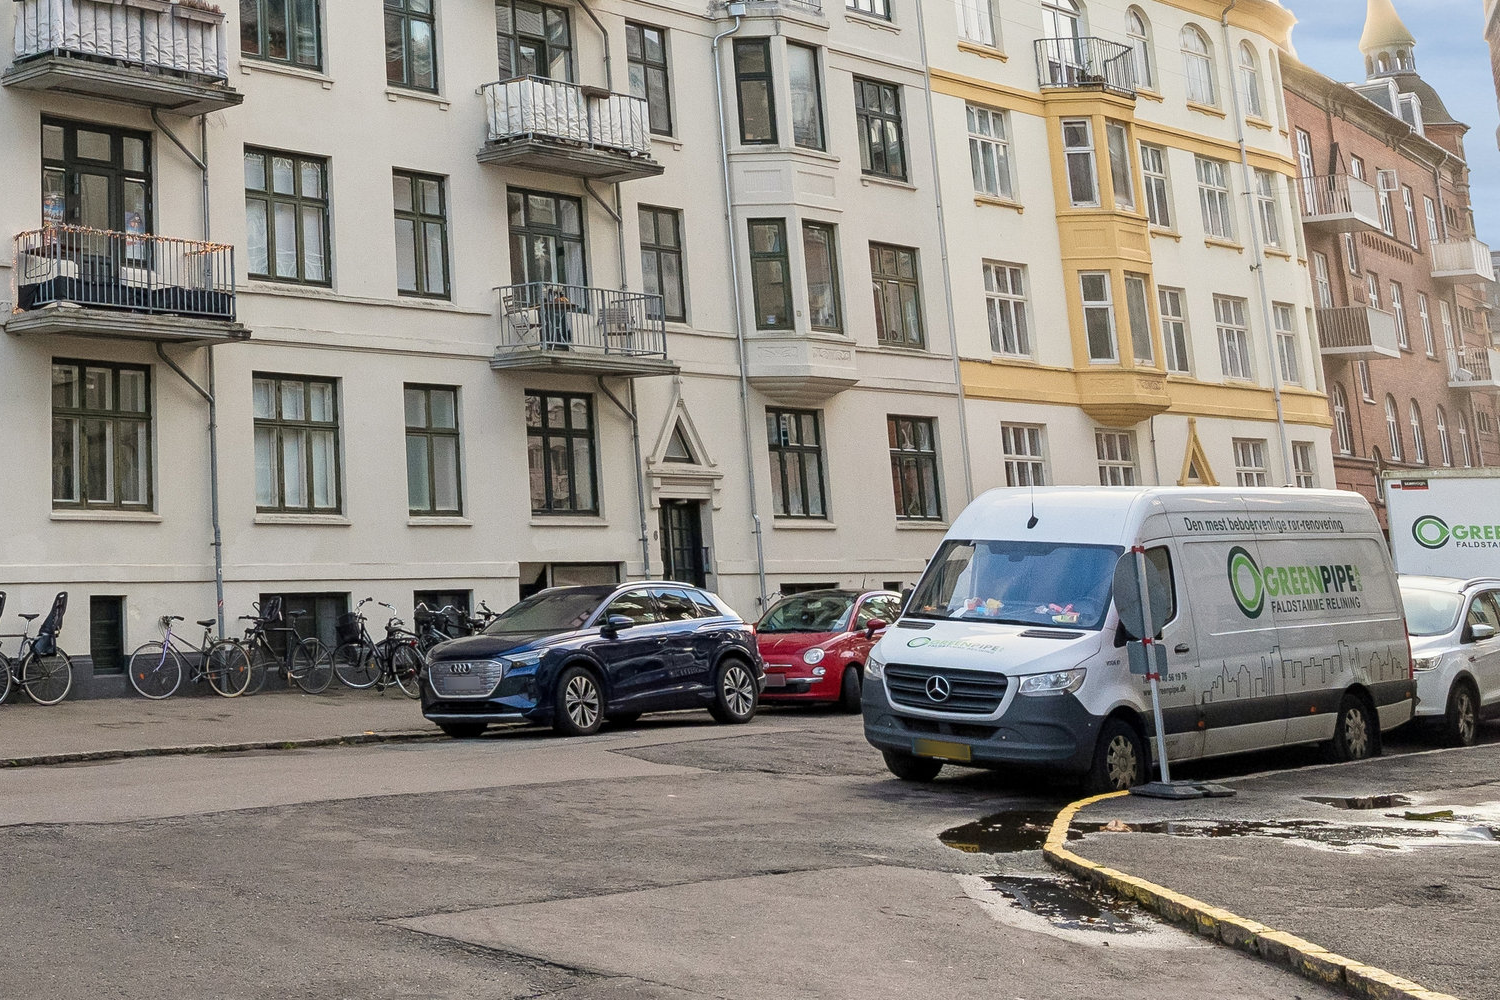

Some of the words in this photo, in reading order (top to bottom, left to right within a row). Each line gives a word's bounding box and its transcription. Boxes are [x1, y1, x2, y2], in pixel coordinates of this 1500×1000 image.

[1184, 517, 1204, 531] Den
[1205, 517, 1228, 531] mest
[1228, 516, 1289, 533] beboervenlige
[1263, 564, 1357, 597] GREENPIPE
[1271, 598, 1325, 613] FALDSTAMME
[1326, 597, 1361, 610] RELINING
